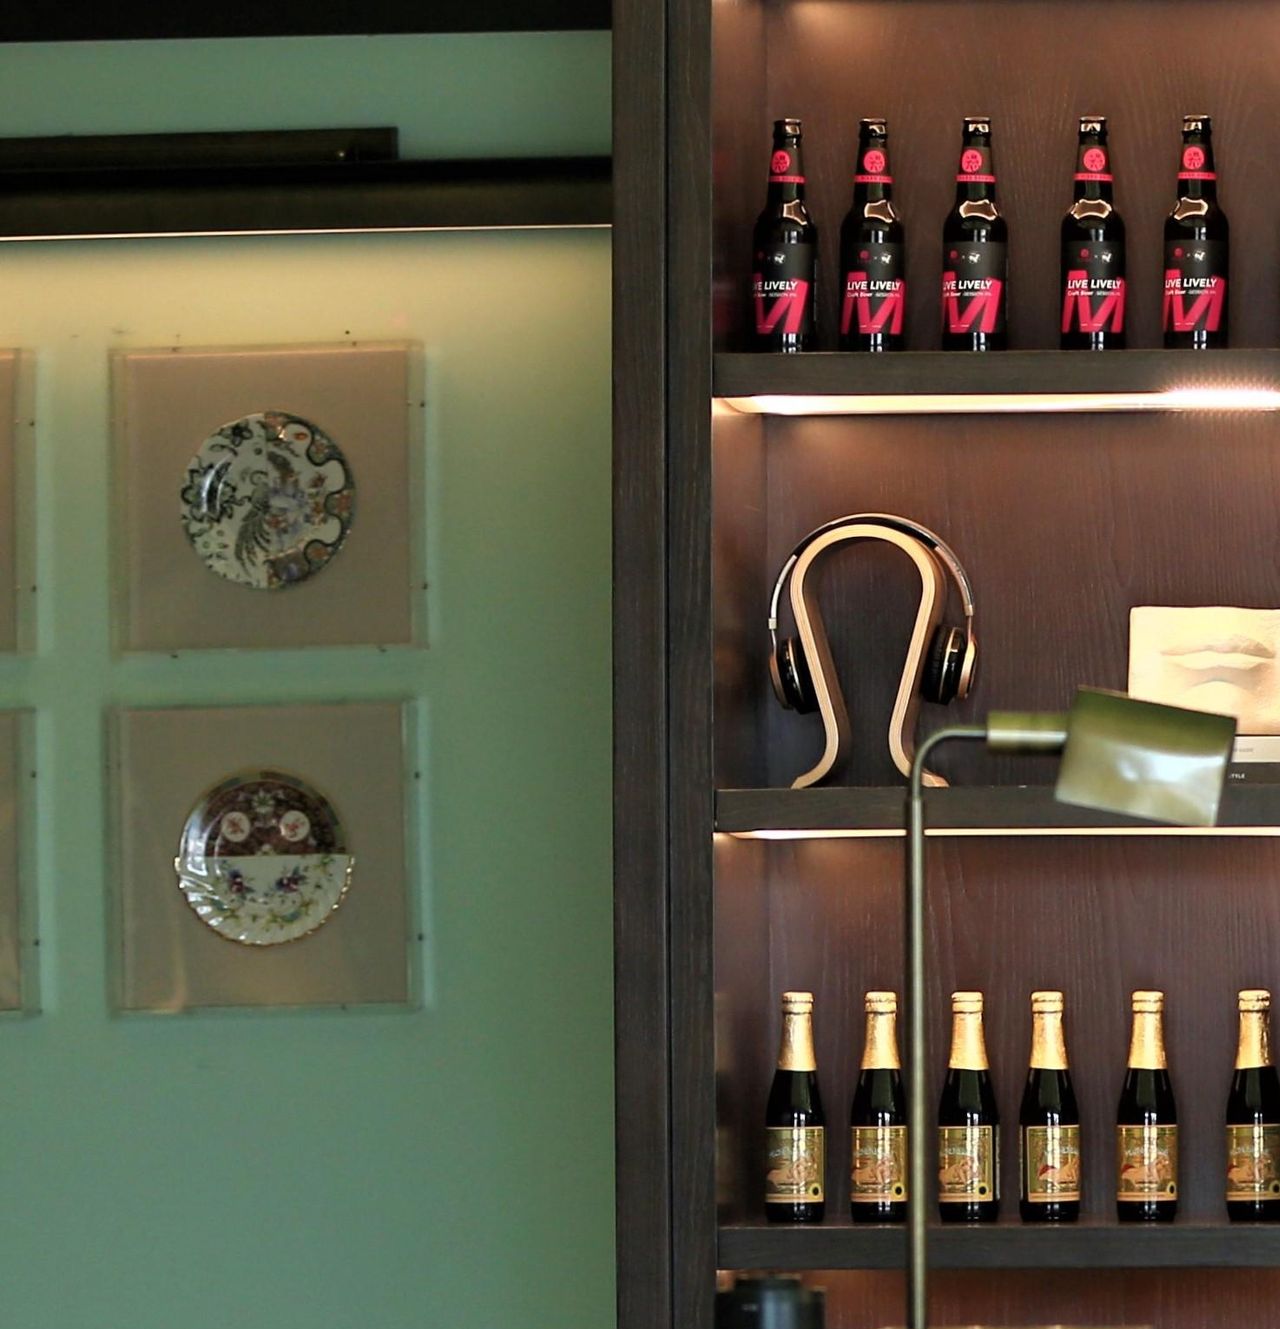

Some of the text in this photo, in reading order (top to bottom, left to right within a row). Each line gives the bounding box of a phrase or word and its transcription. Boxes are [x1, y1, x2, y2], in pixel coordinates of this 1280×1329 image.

[764, 281, 798, 291] LIVELY
[847, 281, 900, 290] LIVE LIVELY
[958, 280, 992, 290] LIVELY
[1068, 279, 1121, 289] LIVE LIVELY
[1183, 278, 1217, 288] LIVELY
